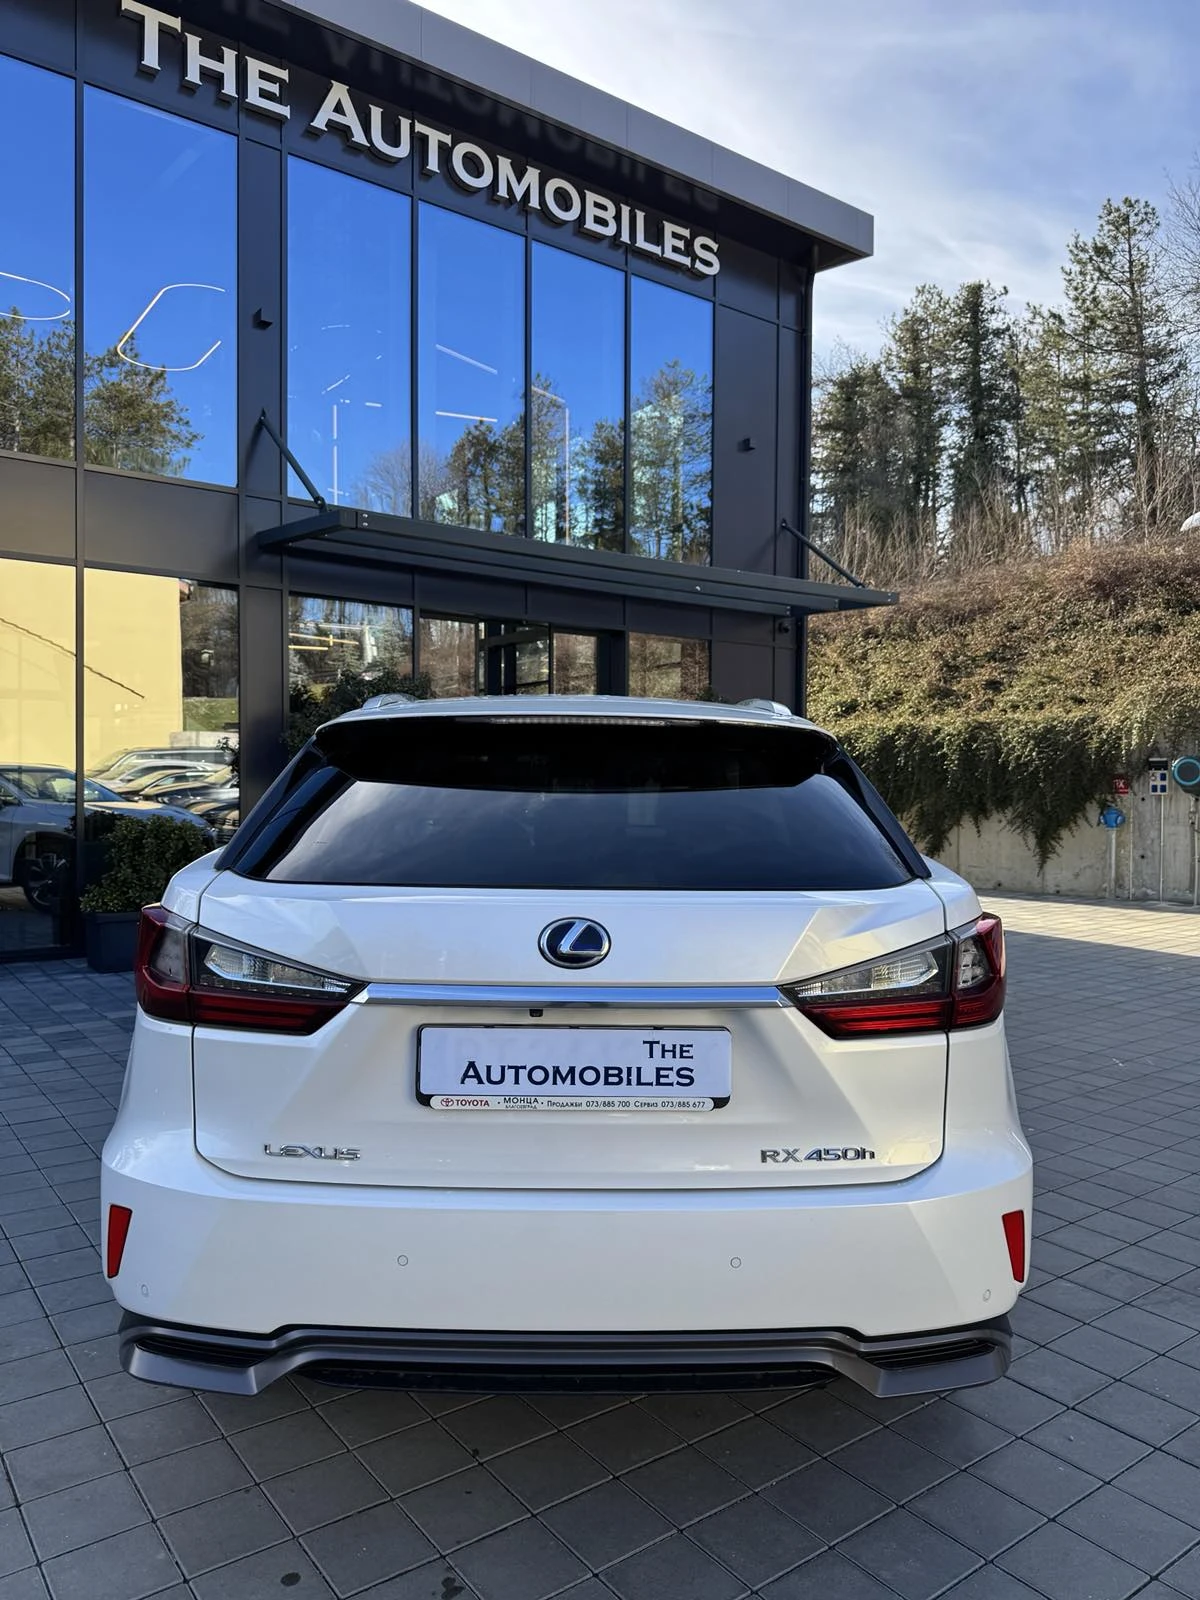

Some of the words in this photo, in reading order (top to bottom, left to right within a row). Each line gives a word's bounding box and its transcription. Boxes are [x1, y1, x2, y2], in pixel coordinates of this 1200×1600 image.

[121, 0, 291, 120] THE
[310, 81, 721, 277] AUTOMOBILES
[642, 1040, 694, 1060] THE
[460, 1061, 695, 1087] AUTOMOBILES
[455, 1099, 490, 1107] TOYOTA
[585, 1100, 616, 1108] 073/885
[617, 1100, 631, 1108] 700
[661, 1101, 691, 1109] 073/885
[692, 1101, 705, 1109] 677
[264, 1144, 361, 1161] LEXUS
[760, 1148, 802, 1163] RX
[803, 1147, 875, 1162] 450h
